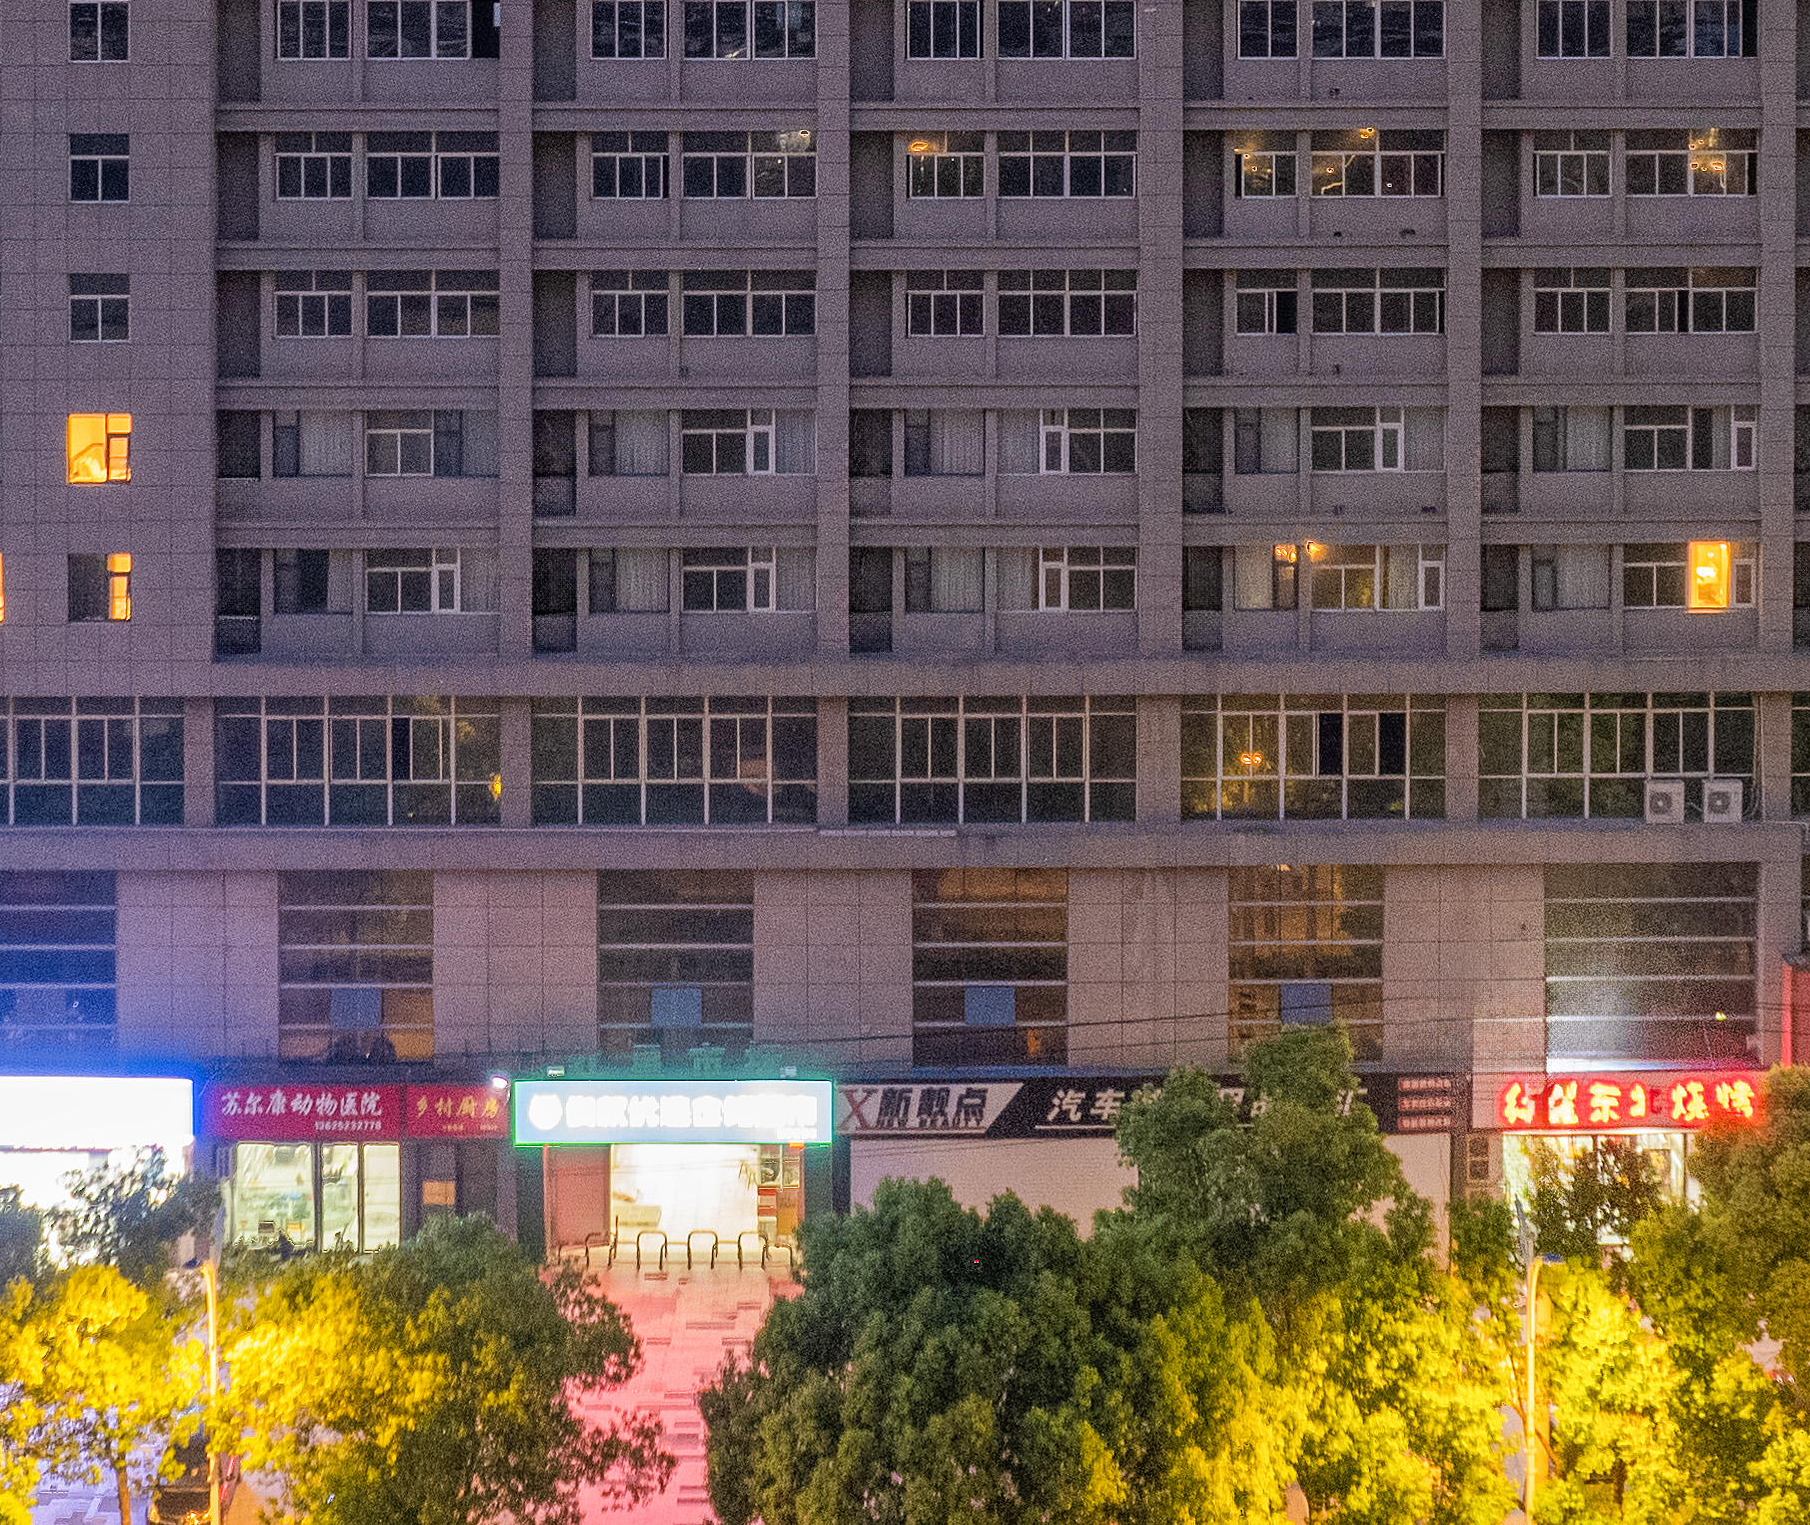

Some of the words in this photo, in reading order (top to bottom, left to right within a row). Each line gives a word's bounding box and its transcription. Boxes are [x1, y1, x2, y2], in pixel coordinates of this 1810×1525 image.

[220, 1089, 384, 1117] 苏尔康动物医院
